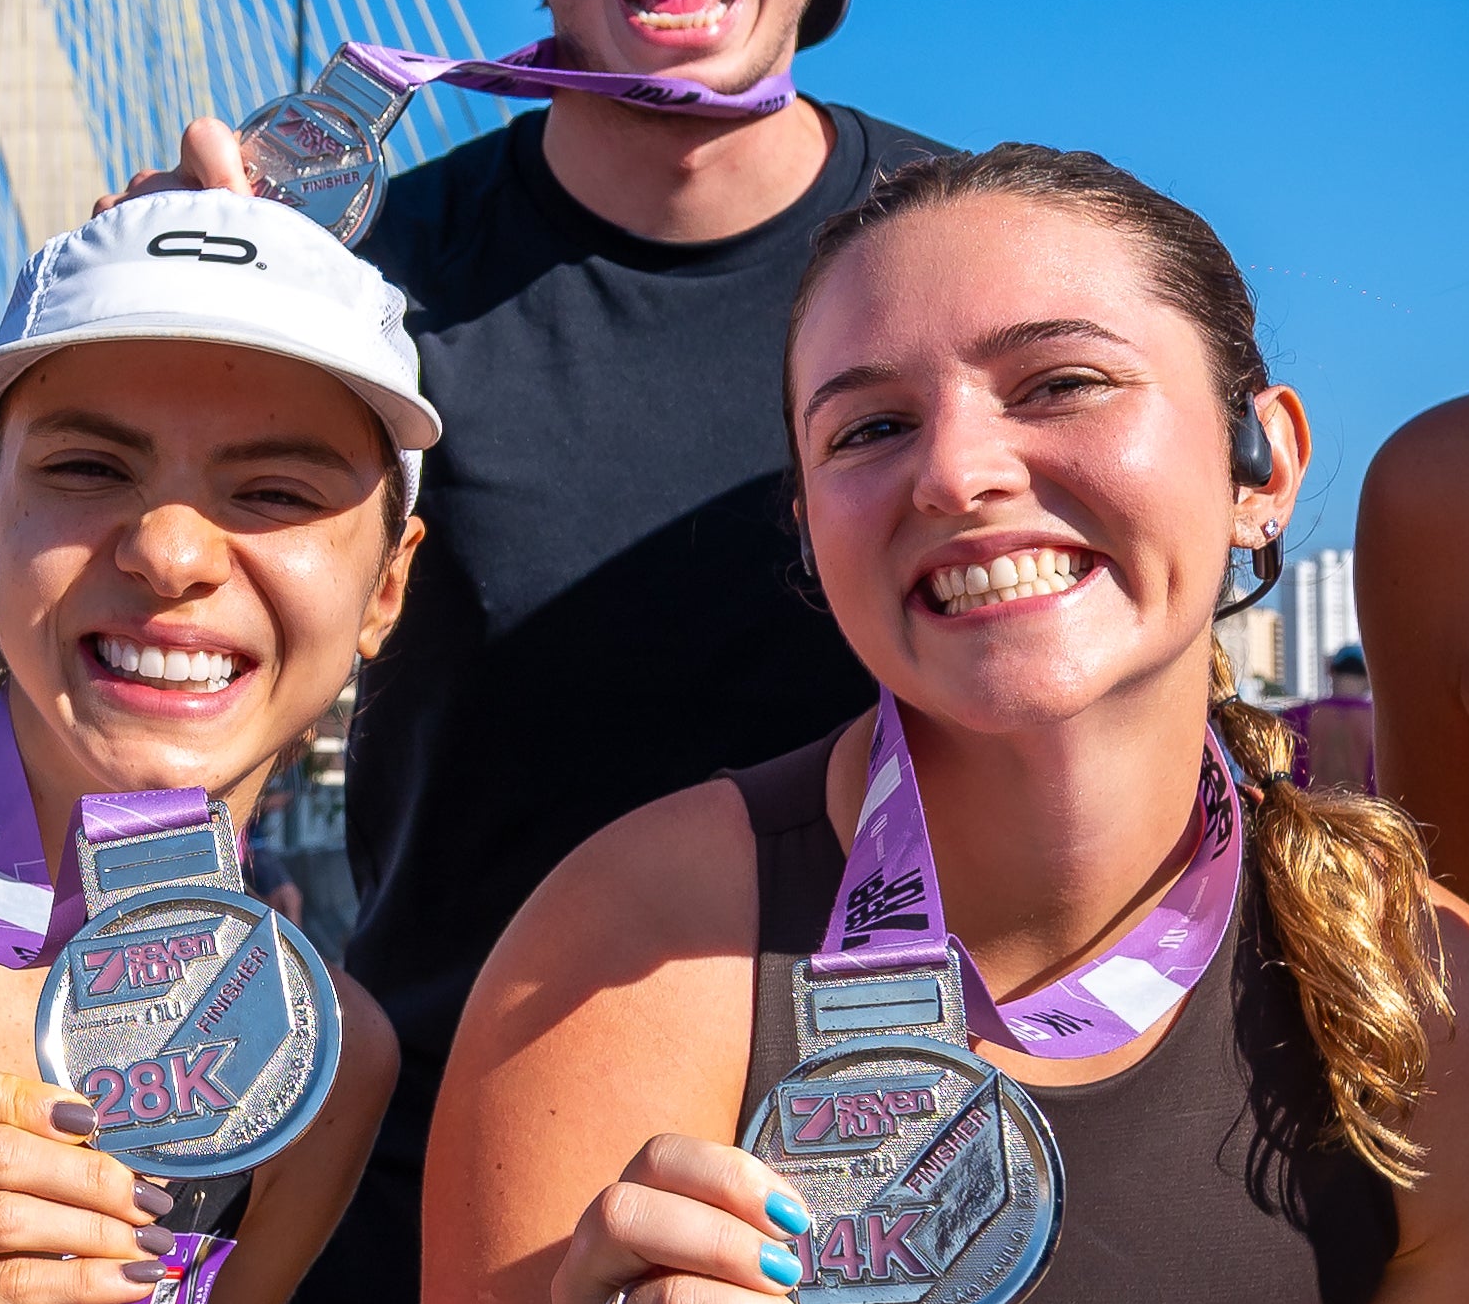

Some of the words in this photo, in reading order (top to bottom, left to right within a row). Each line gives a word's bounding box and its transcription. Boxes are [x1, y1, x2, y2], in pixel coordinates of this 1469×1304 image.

[301, 171, 360, 194] FINISHER
[195, 945, 270, 1035] FINISHER
[84, 1048, 230, 1127] 28K
[836, 1088, 936, 1117] seven
[905, 1109, 990, 1195] FINISHER
[795, 1212, 930, 1284] 14K
